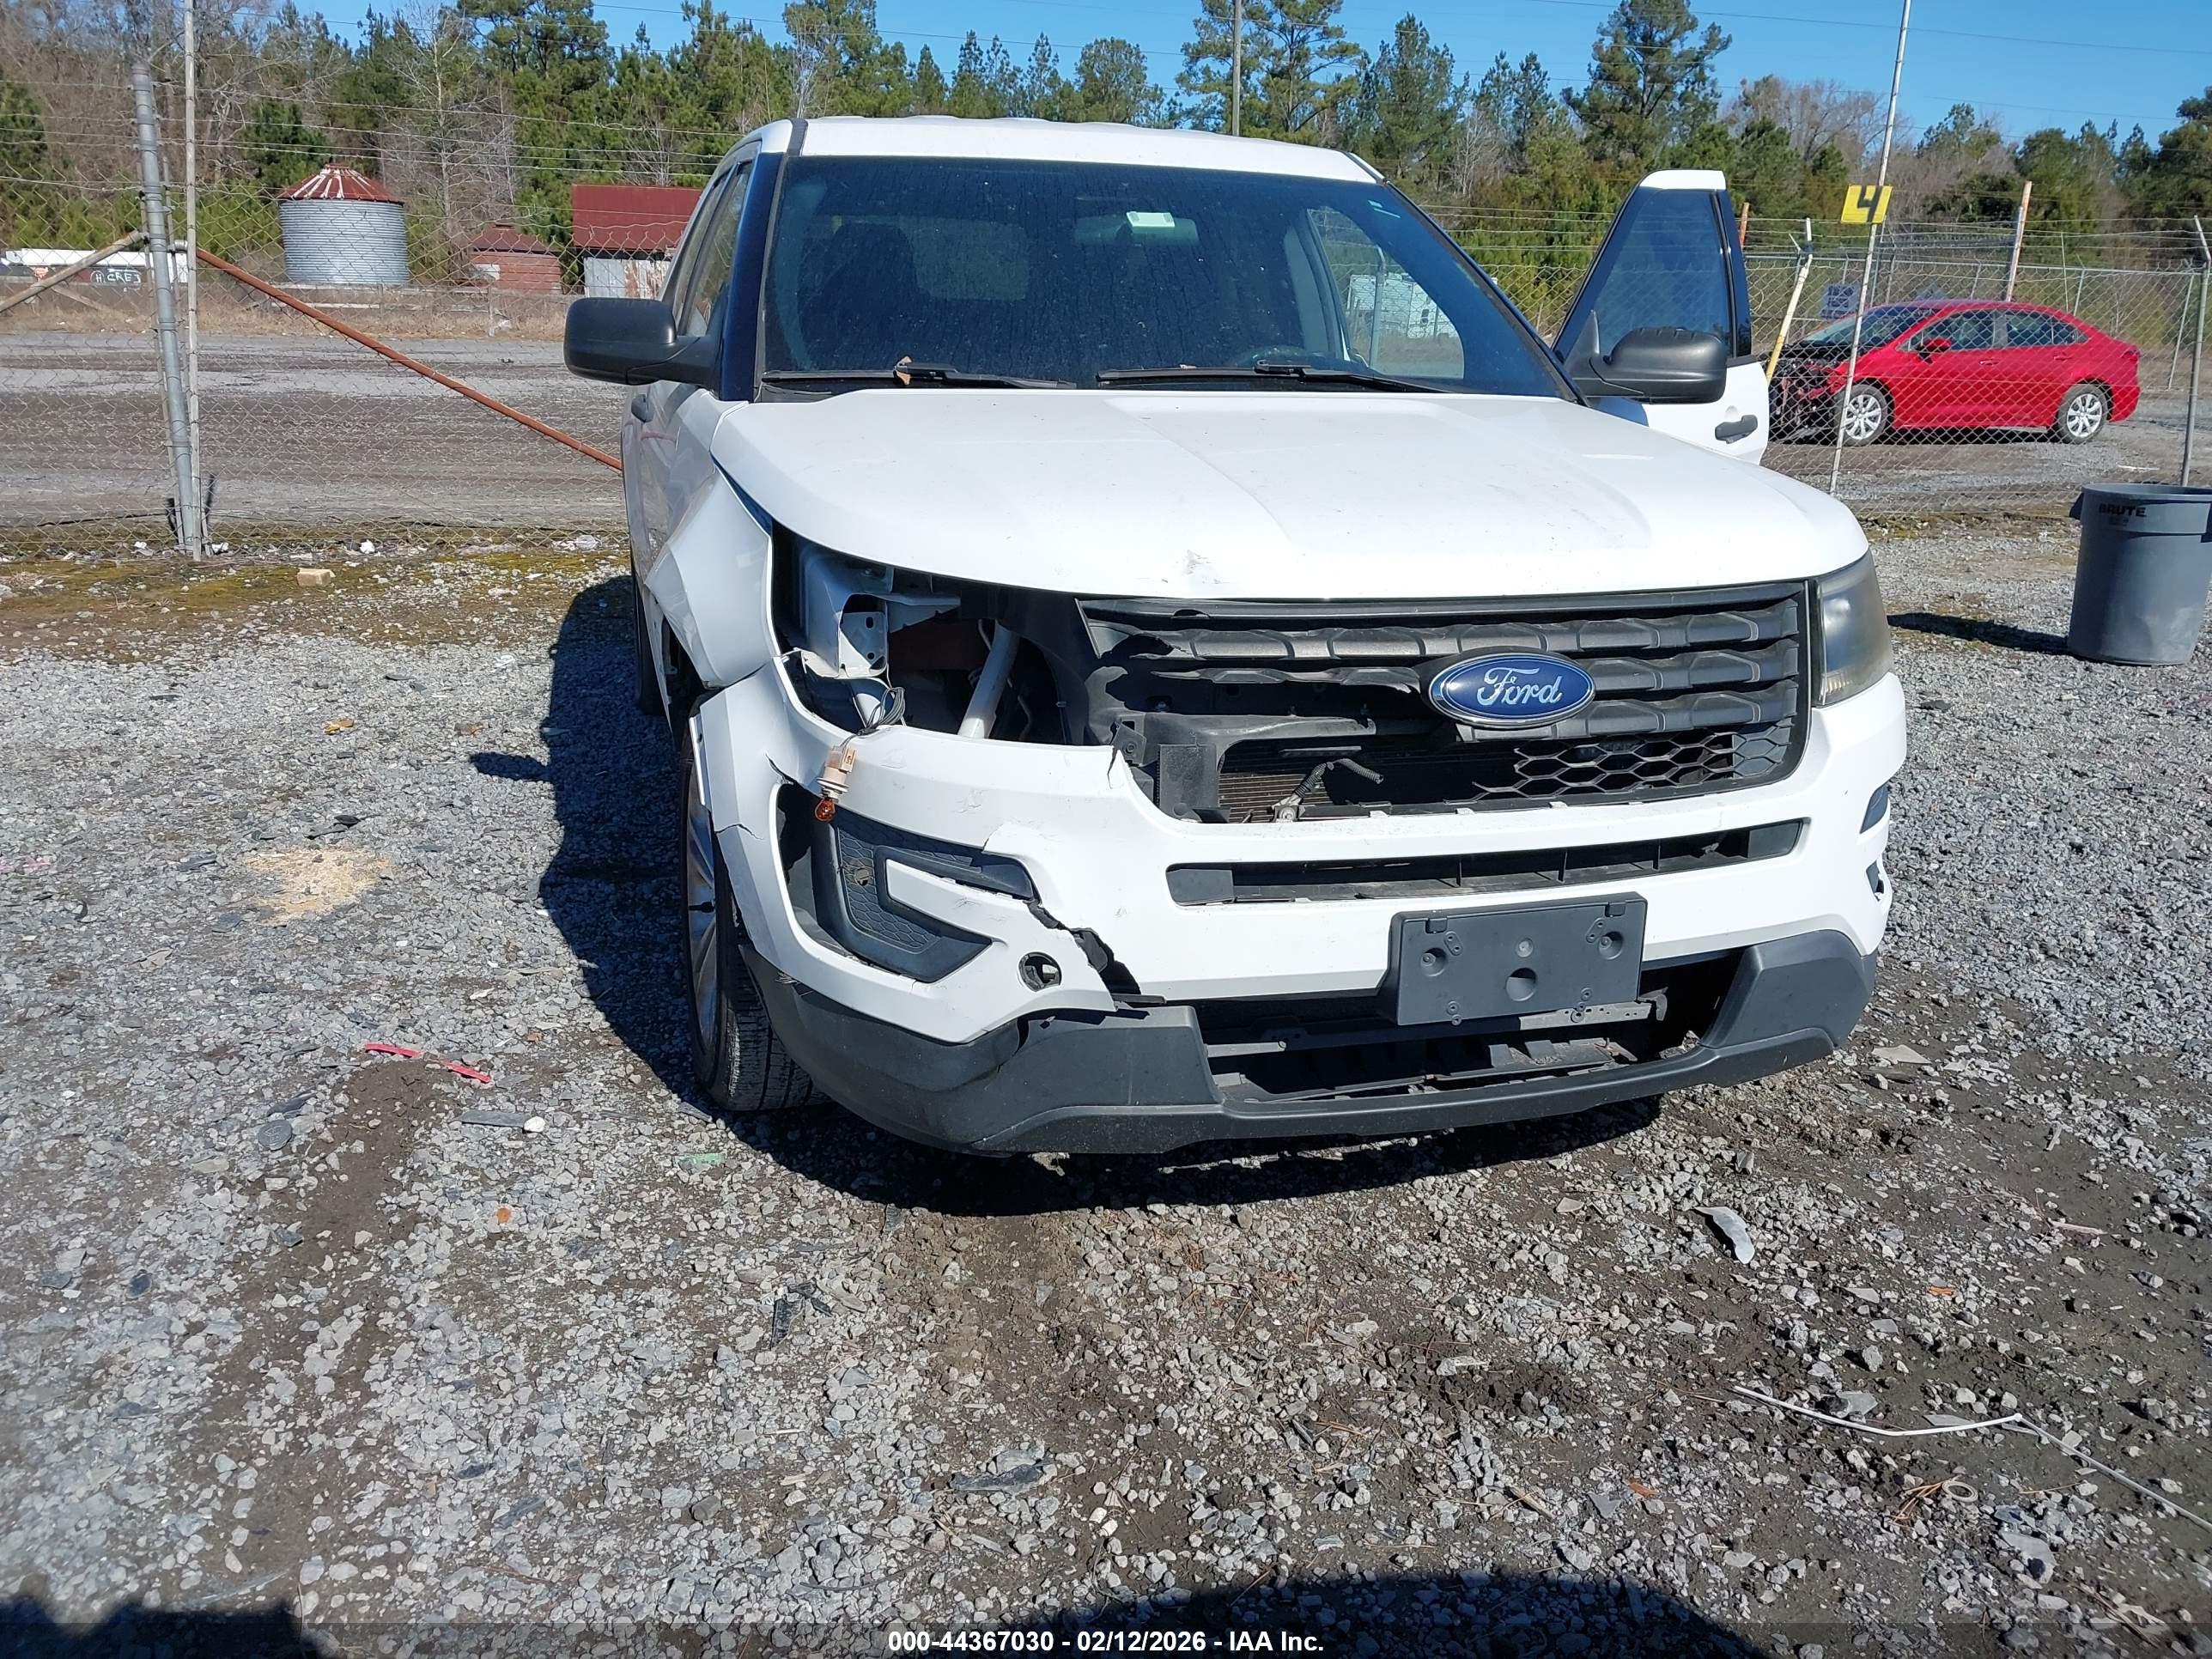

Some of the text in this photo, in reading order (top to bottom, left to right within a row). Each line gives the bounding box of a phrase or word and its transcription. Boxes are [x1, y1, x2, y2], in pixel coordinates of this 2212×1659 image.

[1856, 185, 1883, 223] 4
[2099, 502, 2147, 518] BRUTE
[1476, 666, 1563, 706] Ford
